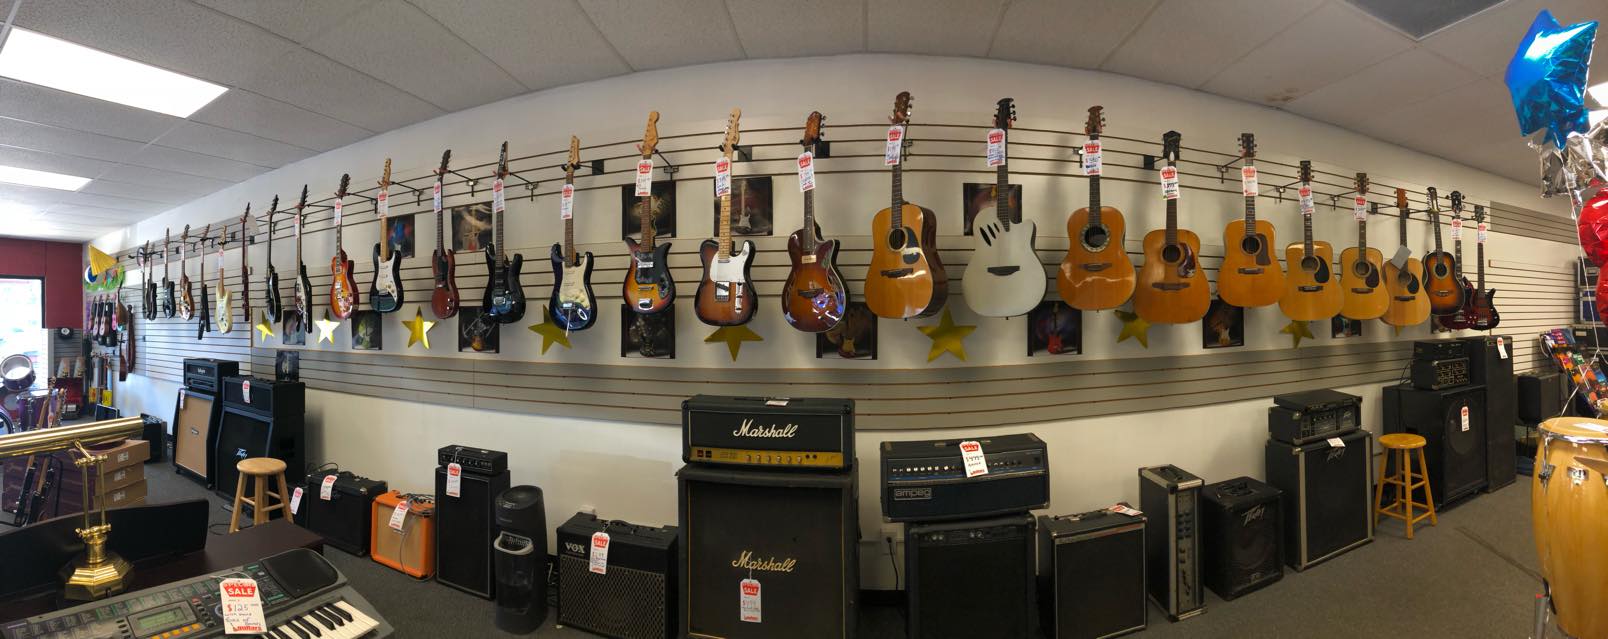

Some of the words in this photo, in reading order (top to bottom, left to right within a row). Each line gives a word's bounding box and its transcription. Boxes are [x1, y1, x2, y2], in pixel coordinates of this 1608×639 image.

[733, 418, 798, 438] Marshall
[565, 542, 585, 553] VOX
[732, 550, 797, 572] Marshall
[228, 587, 254, 595] SALE
